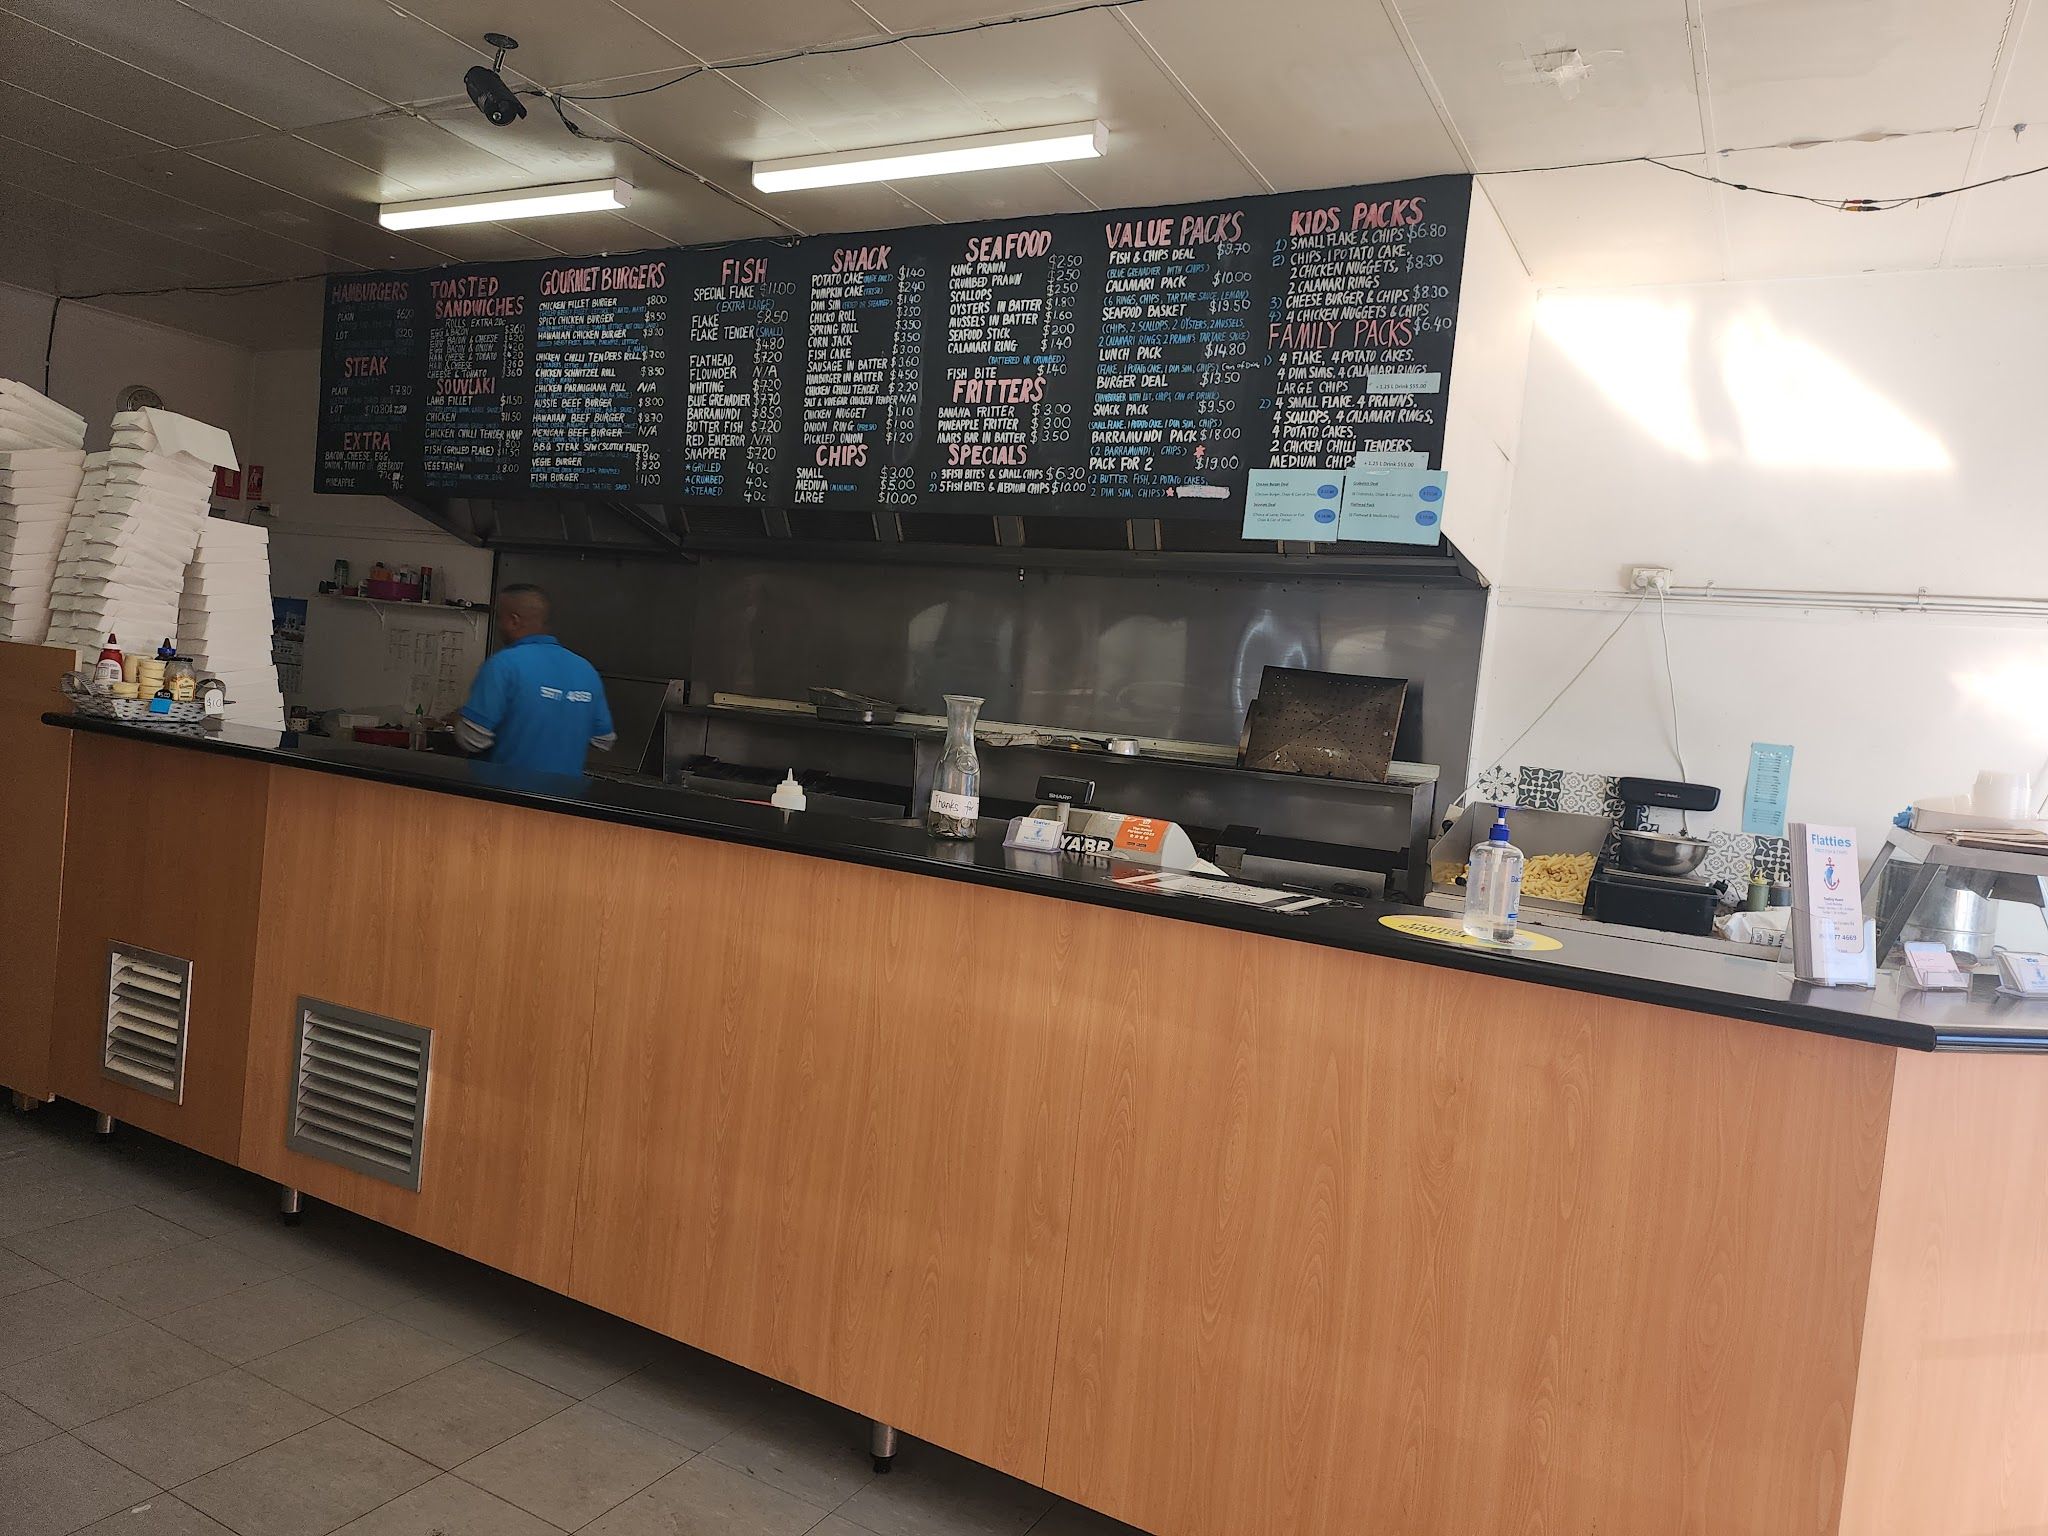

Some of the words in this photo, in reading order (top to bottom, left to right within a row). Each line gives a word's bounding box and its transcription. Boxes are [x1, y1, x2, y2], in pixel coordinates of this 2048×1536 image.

[1290, 206, 1341, 236] KIDS
[1351, 197, 1426, 230] PACKS
[1106, 219, 1174, 249] VALUE
[1180, 211, 1244, 246] PACKS
[965, 230, 1052, 263] SEAFOOD
[1290, 233, 1326, 251] SMALL
[1328, 229, 1358, 248] FLAKE
[1371, 227, 1404, 244] CHIPS
[832, 245, 892, 273] SNACK
[1109, 251, 1131, 265] FISH
[1143, 249, 1169, 263] CHIPS
[1172, 249, 1195, 261] DEAL
[1334, 245, 1374, 262] POTATO
[721, 257, 769, 286] FISH
[951, 263, 973, 277] KING
[977, 261, 1006, 275] PRAWN
[1299, 261, 1343, 278] CHICKEN
[540, 267, 600, 295] GOURMET
[601, 262, 666, 291] BURGERS
[811, 274, 841, 287] POTATO
[843, 272, 864, 285] CAKE
[949, 276, 988, 290] CRUMBED
[991, 273, 1023, 287] PRAWN
[1105, 277, 1155, 293] CALAMARI
[1160, 276, 1188, 290] PACK
[1299, 276, 1346, 293] CALAMARI
[1347, 274, 1381, 289] RINGS
[332, 282, 408, 303] HAMBURGERS
[430, 276, 499, 299] TOASTED
[694, 286, 726, 301] SPECIAL
[730, 285, 755, 300] FLAKE
[811, 287, 842, 300] PUMPKIN
[844, 286, 865, 298] CAKE
[950, 289, 992, 303] SCALLOPS
[1286, 293, 1323, 309] CHEESE
[1325, 289, 1363, 307] BURGER
[1377, 288, 1409, 303] CHIPS
[435, 296, 525, 320] SANDWICHES
[539, 301, 566, 311] CHICKEN
[568, 299, 590, 310] FILLET
[592, 298, 618, 308] BURGER
[950, 301, 990, 316] OYSTERS
[997, 300, 1005, 313] IN
[1008, 299, 1042, 313] BATTER
[1297, 306, 1339, 322] CHICKEN
[1341, 304, 1387, 320] NUGGETS
[1399, 302, 1430, 317] CHIPS
[809, 312, 835, 324] CHICKO
[838, 310, 856, 323] ROLL
[1102, 306, 1142, 321] SEAFOOD
[1147, 304, 1187, 317] BASKET
[692, 313, 720, 328] FLAKE
[948, 315, 985, 329] MUSSELS
[988, 313, 999, 326] IN
[1002, 312, 1038, 326] BATTER
[691, 327, 718, 341] FLAKE
[724, 325, 755, 340] TENDER
[809, 323, 839, 336] SPRING
[840, 322, 859, 334] ROLL
[948, 328, 982, 342] SEAFOOD
[986, 327, 1011, 340] STICK
[1268, 321, 1343, 350] FAMILY
[1353, 318, 1412, 348] PACKS
[807, 336, 828, 348] CORN
[831, 335, 852, 347] JACK
[948, 340, 991, 354] CALAMARI
[994, 340, 1019, 353] RING
[690, 354, 734, 368] FLATHEAD
[808, 349, 827, 361] FISH
[830, 348, 851, 360] CAKE
[1099, 347, 1130, 361] LUNCH
[1137, 346, 1162, 360] PACK
[1292, 351, 1326, 366] FLAKE,
[1341, 350, 1376, 364] POTATO
[345, 355, 389, 378] STEAK
[536, 368, 561, 378] CHICKEN
[564, 368, 599, 378] SCHNITZEL
[601, 368, 616, 377] ROLL
[690, 366, 737, 380] FLOUNDER
[752, 365, 778, 378] N/A
[807, 360, 842, 373] SAUSAGE
[858, 358, 888, 370] BATTER
[1288, 366, 1308, 380] DIM
[947, 367, 967, 380] FISH
[975, 367, 998, 379] BITE
[436, 378, 496, 396] SOUVLAKI
[690, 381, 725, 394] WHITING
[1097, 375, 1136, 389] BURGER
[1141, 374, 1168, 388] DEAL
[1276, 381, 1313, 395] LARGE
[1319, 380, 1349, 395] CHIPS
[953, 377, 1046, 404] FRITTERS
[534, 399, 558, 408] AUSSIE
[561, 399, 582, 408] BEEF
[585, 398, 613, 408] BURGER
[688, 394, 707, 407] BLUE
[709, 393, 751, 407] GRENADIER
[1287, 397, 1319, 410] SMALL
[687, 407, 741, 421] BARRAMUNDI
[938, 407, 970, 418] BANANA
[976, 405, 1015, 418] FRITTER
[1093, 403, 1120, 417] SNACK
[1126, 403, 1149, 416] PACK
[1346, 410, 1396, 424] CALAMARI
[686, 420, 719, 433] BUTTER
[724, 420, 743, 433] FISH
[804, 421, 827, 433] ONION
[832, 421, 855, 432] RING
[938, 419, 978, 431] PINEAPPLE
[983, 418, 1019, 431] FRITTER
[1283, 425, 1319, 439] POTATO
[343, 431, 390, 451] EXTRA
[686, 434, 704, 447] RED
[708, 434, 745, 447] EMPEROR
[804, 433, 835, 444] PICKLED
[840, 432, 864, 444] ONION
[937, 432, 961, 444] MARS
[963, 432, 979, 443] BAR
[994, 431, 1027, 443] BATTER
[1091, 429, 1162, 444] BARRAMUNDI
[1169, 430, 1198, 442] PACK
[685, 447, 727, 460] SNAPPER
[1283, 440, 1323, 454] CHICKEN
[1326, 440, 1357, 454] CHILLI
[532, 457, 551, 467] VEGIE
[555, 458, 582, 467] BURGER
[815, 445, 868, 467] CHIPS
[948, 444, 1027, 466] SPECIALS
[1269, 456, 1317, 469] MEDIUM
[1089, 457, 1116, 471] PACK
[1120, 457, 1139, 471] FOR
[1144, 457, 1155, 471] 2
[530, 474, 547, 483] FISH
[550, 474, 579, 483] BURGER
[796, 467, 824, 479] SMALL
[1100, 475, 1128, 485] BUTTER
[795, 478, 828, 492] MEDIUM
[794, 490, 825, 504] LARGE
[935, 794, 959, 812] Thanks
[1048, 792, 1073, 801] SHARP
[1811, 833, 1852, 848] Flatties
